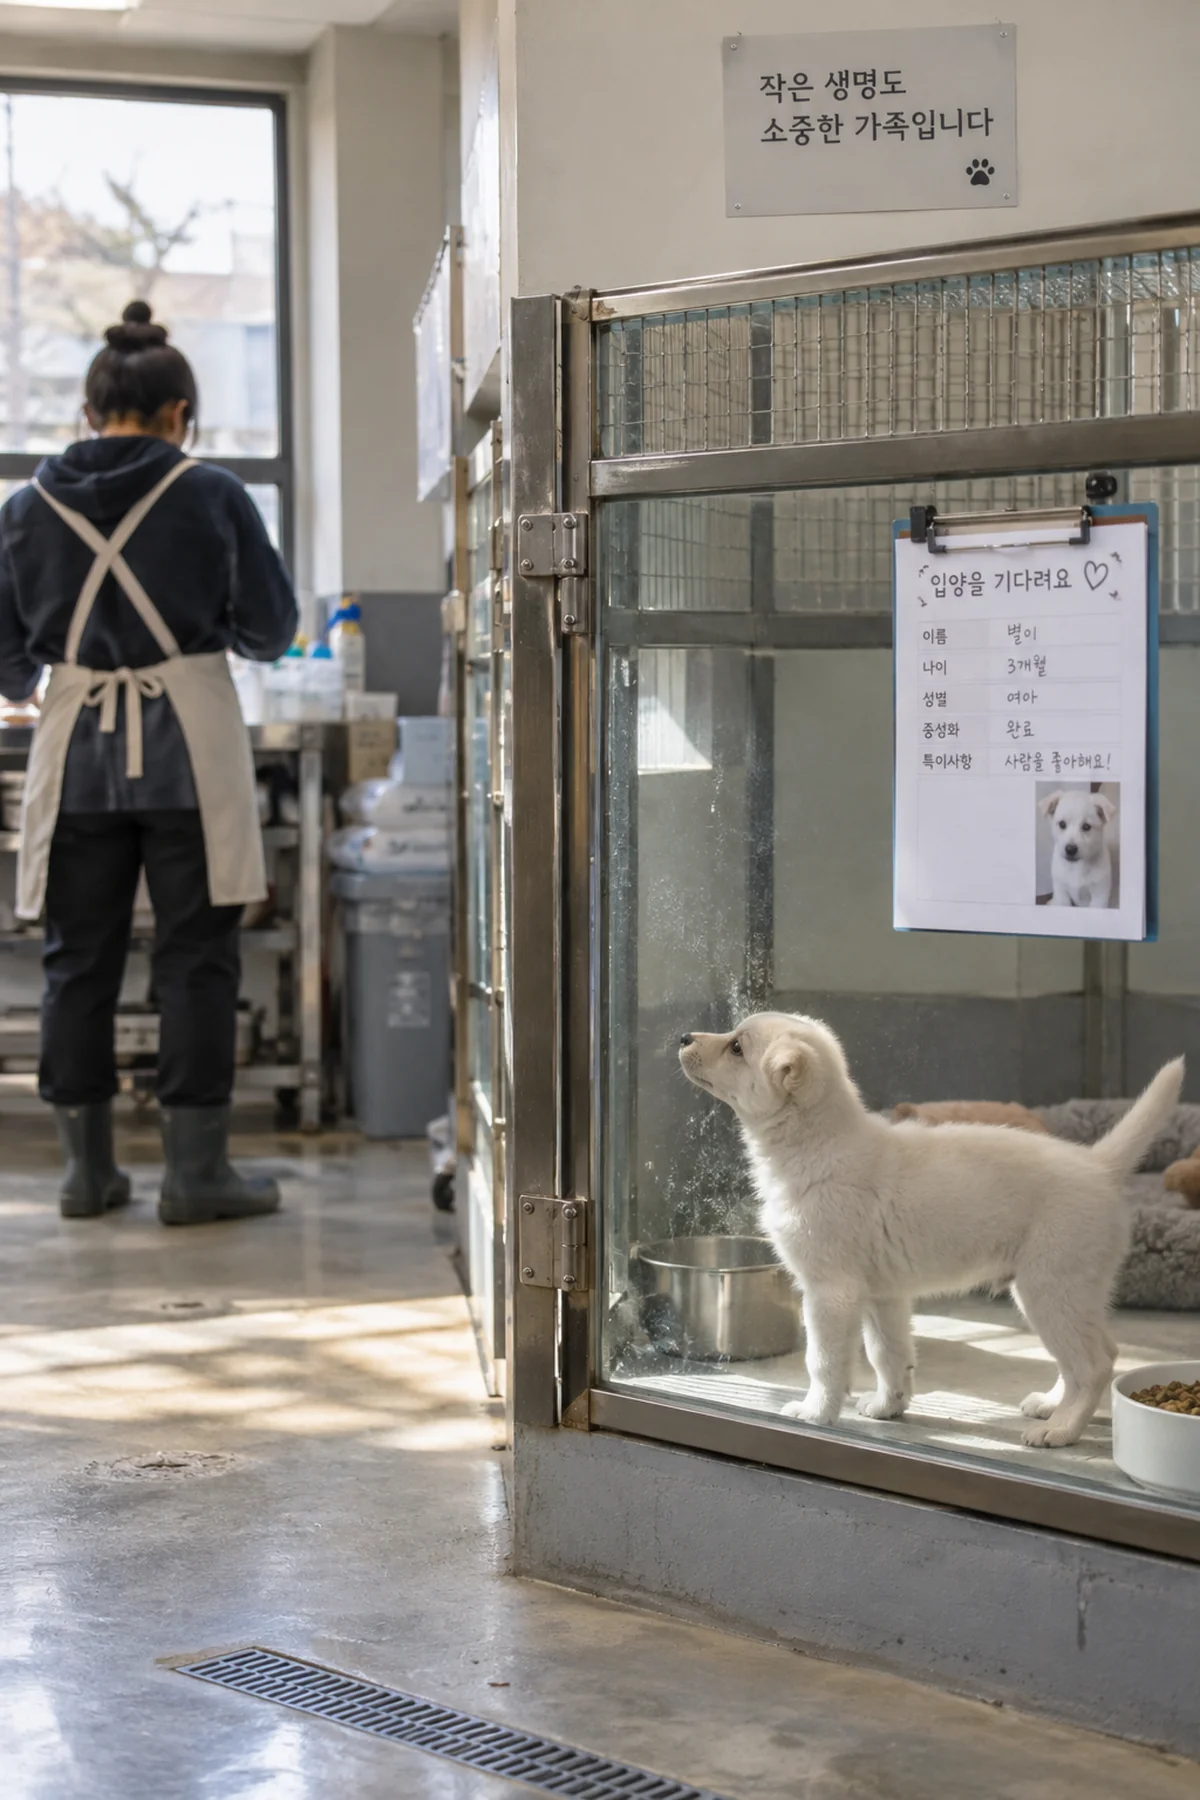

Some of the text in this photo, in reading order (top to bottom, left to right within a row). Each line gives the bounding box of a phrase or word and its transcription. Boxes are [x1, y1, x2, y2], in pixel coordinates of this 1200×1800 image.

[760, 69, 907, 104] 작은 생명도
[760, 107, 994, 146] 소중한 가족입니다
[930, 568, 1073, 598] 입양을 기다려요
[922, 623, 1037, 645] 이름 별이
[922, 654, 1047, 677] 나이 3개월
[922, 689, 1038, 708] 성별 여아
[922, 720, 1035, 740] 중성화 완료
[922, 751, 1112, 774] 특이사항 사람을 좋아해요!
